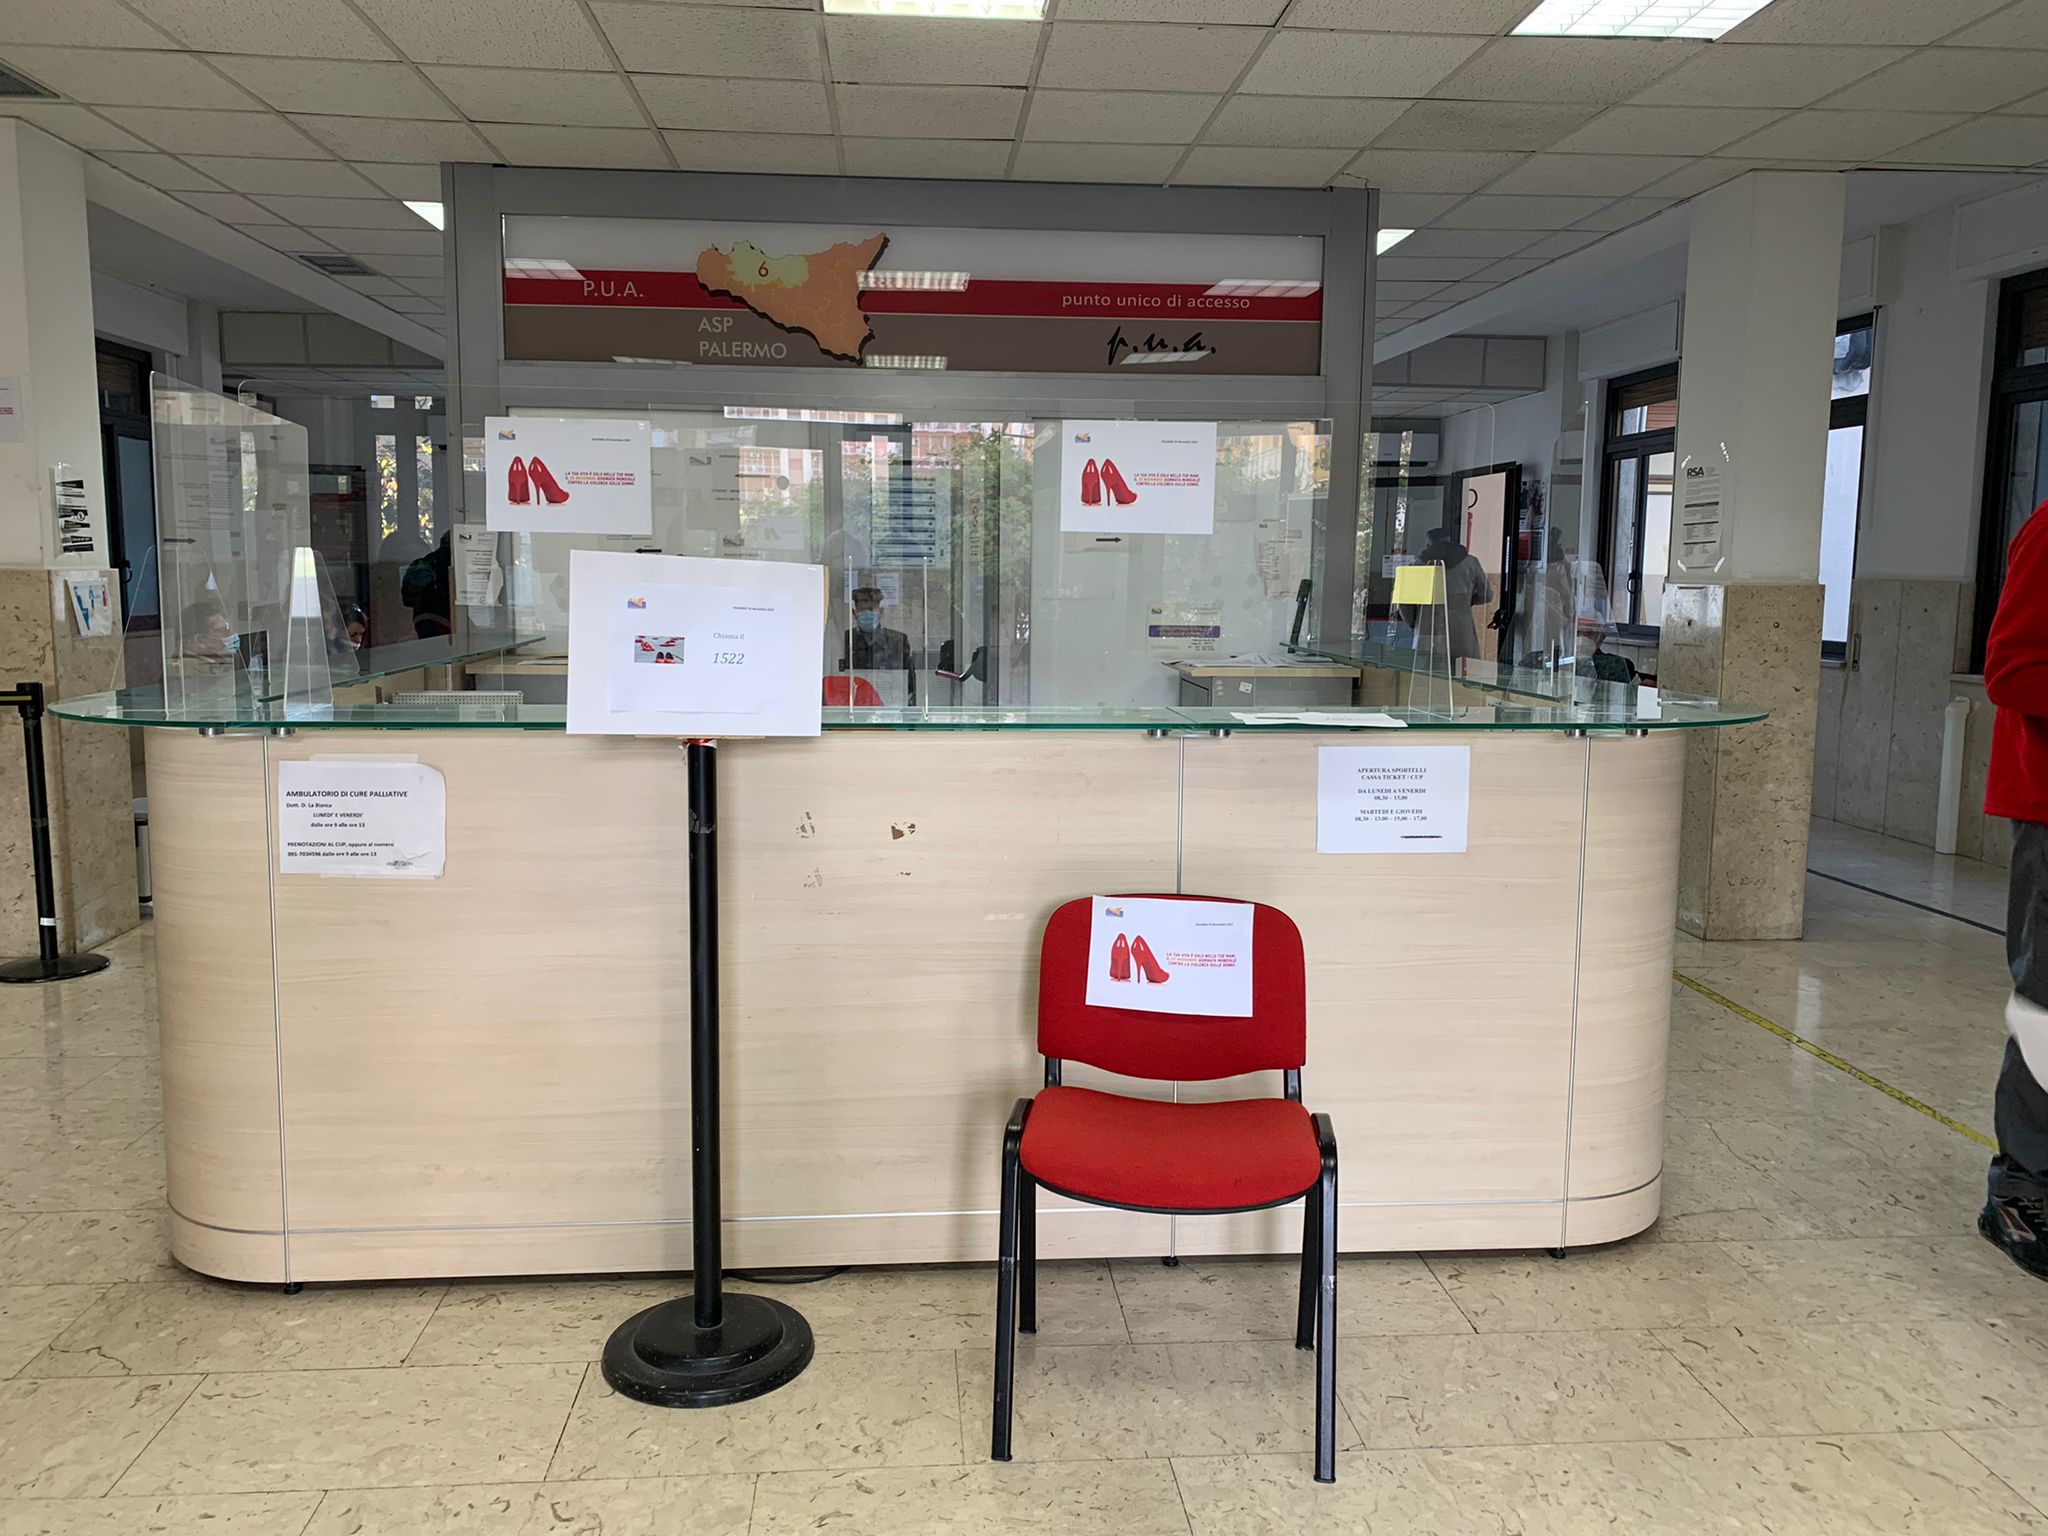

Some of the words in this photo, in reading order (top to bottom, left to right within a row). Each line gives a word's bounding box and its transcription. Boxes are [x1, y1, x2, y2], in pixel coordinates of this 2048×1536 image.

[758, 260, 769, 277] 6
[583, 280, 644, 297] P.U.A.
[1062, 294, 1111, 308] punto
[1117, 294, 1161, 307] unico
[1167, 294, 1181, 307] di
[1187, 297, 1250, 309] accesso
[698, 316, 733, 333] ASP
[699, 341, 787, 359] PALERMO
[1107, 326, 1216, 365] p.u.a.
[1687, 467, 1704, 477] RSA
[713, 631, 738, 640] Chiama
[712, 653, 744, 665] 1522
